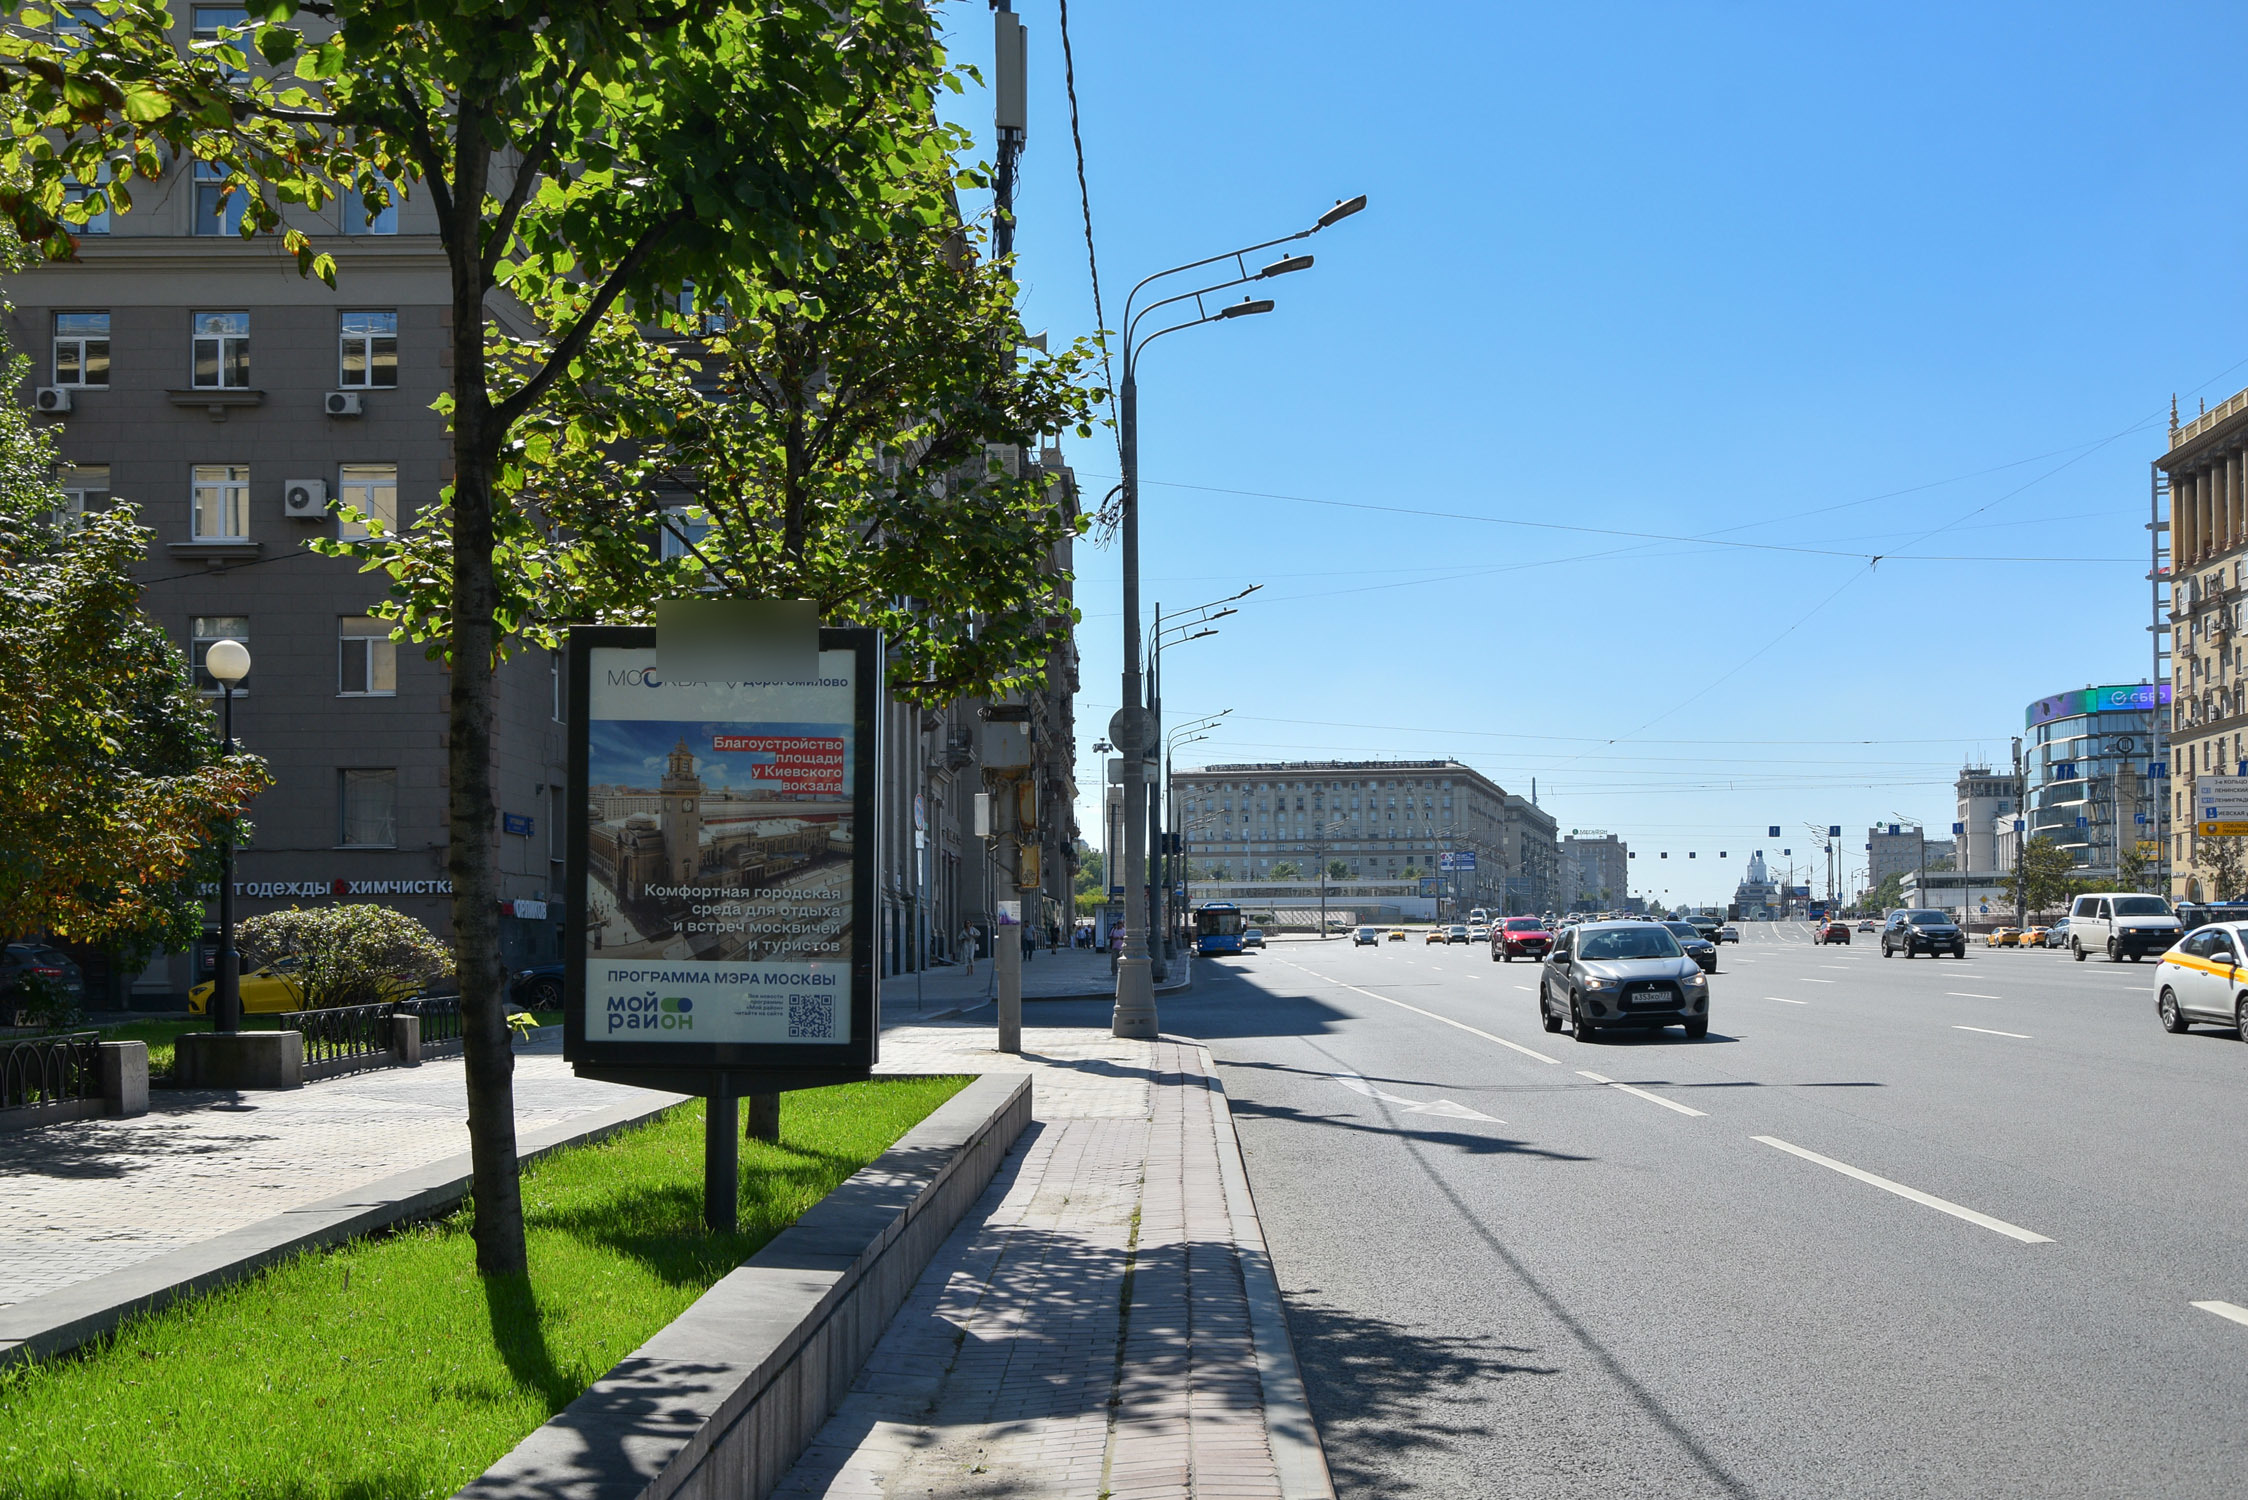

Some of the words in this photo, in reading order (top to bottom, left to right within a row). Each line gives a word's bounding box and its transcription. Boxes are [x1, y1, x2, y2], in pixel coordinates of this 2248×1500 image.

[714, 736, 843, 751] Благоустройство
[776, 754, 842, 765] площади
[752, 767, 760, 779] у
[765, 765, 842, 777] Киевского
[782, 782, 842, 791] вокзала
[246, 881, 331, 898] одежды
[644, 884, 750, 899] Комфортная
[754, 887, 841, 900] городская
[692, 904, 741, 916] среда
[745, 905, 776, 916] для
[780, 907, 840, 917] отдыха
[673, 922, 683, 932] и
[687, 921, 745, 935] встреч
[750, 922, 840, 934] москвичей
[748, 941, 757, 950] и
[763, 941, 840, 954] туристов
[608, 970, 710, 984] ПРОГРАММА
[714, 972, 760, 985] МЭРА
[764, 973, 836, 986] МОСКВЫ
[606, 991, 658, 1013] мой
